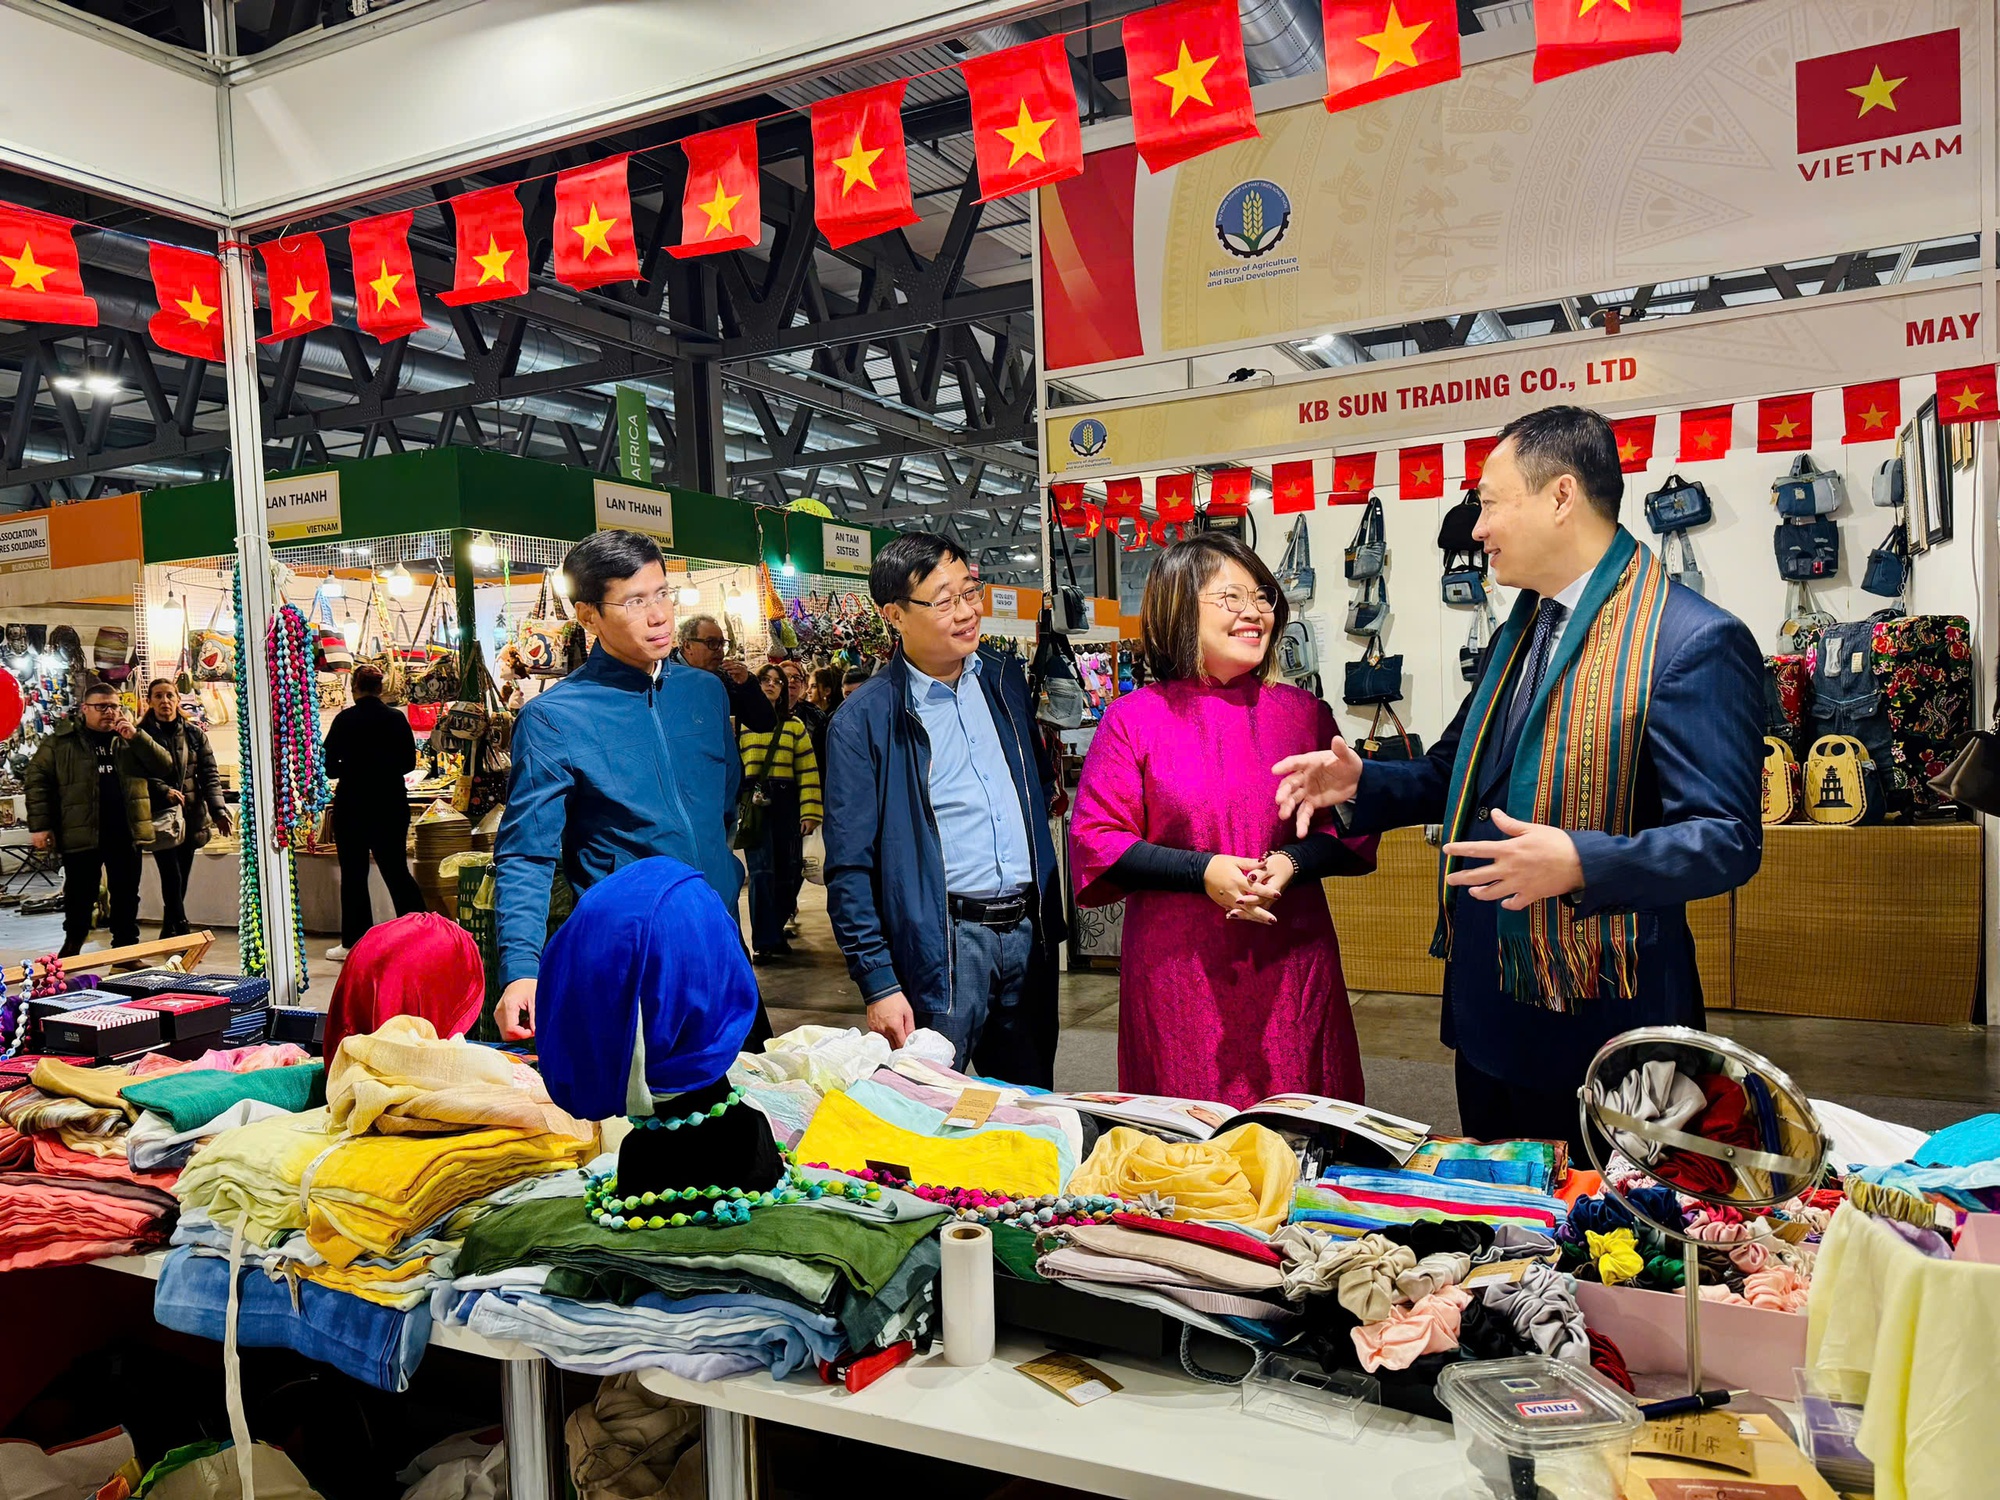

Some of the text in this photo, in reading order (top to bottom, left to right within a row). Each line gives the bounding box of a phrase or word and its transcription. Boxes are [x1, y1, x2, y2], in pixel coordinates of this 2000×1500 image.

[1797, 134, 1962, 182] VIETNAM
[1207, 265, 1299, 287] and Rural Development
[1209, 256, 1297, 278] Ministry of Agriculture
[1905, 312, 1981, 347] MAY
[1298, 357, 1637, 424] KB SUN TRADING CO., LTD
[628, 414, 641, 480] AFRICA
[266, 489, 327, 509] LAN THANH
[606, 497, 662, 517] LAN THANH
[306, 522, 338, 534] VIETNAM
[835, 532, 859, 544] AN TAM
[11, 539, 45, 551] SOLIDAIRES
[836, 545, 859, 557] SISTERS
[1525, 1403, 1578, 1414] FATINA
